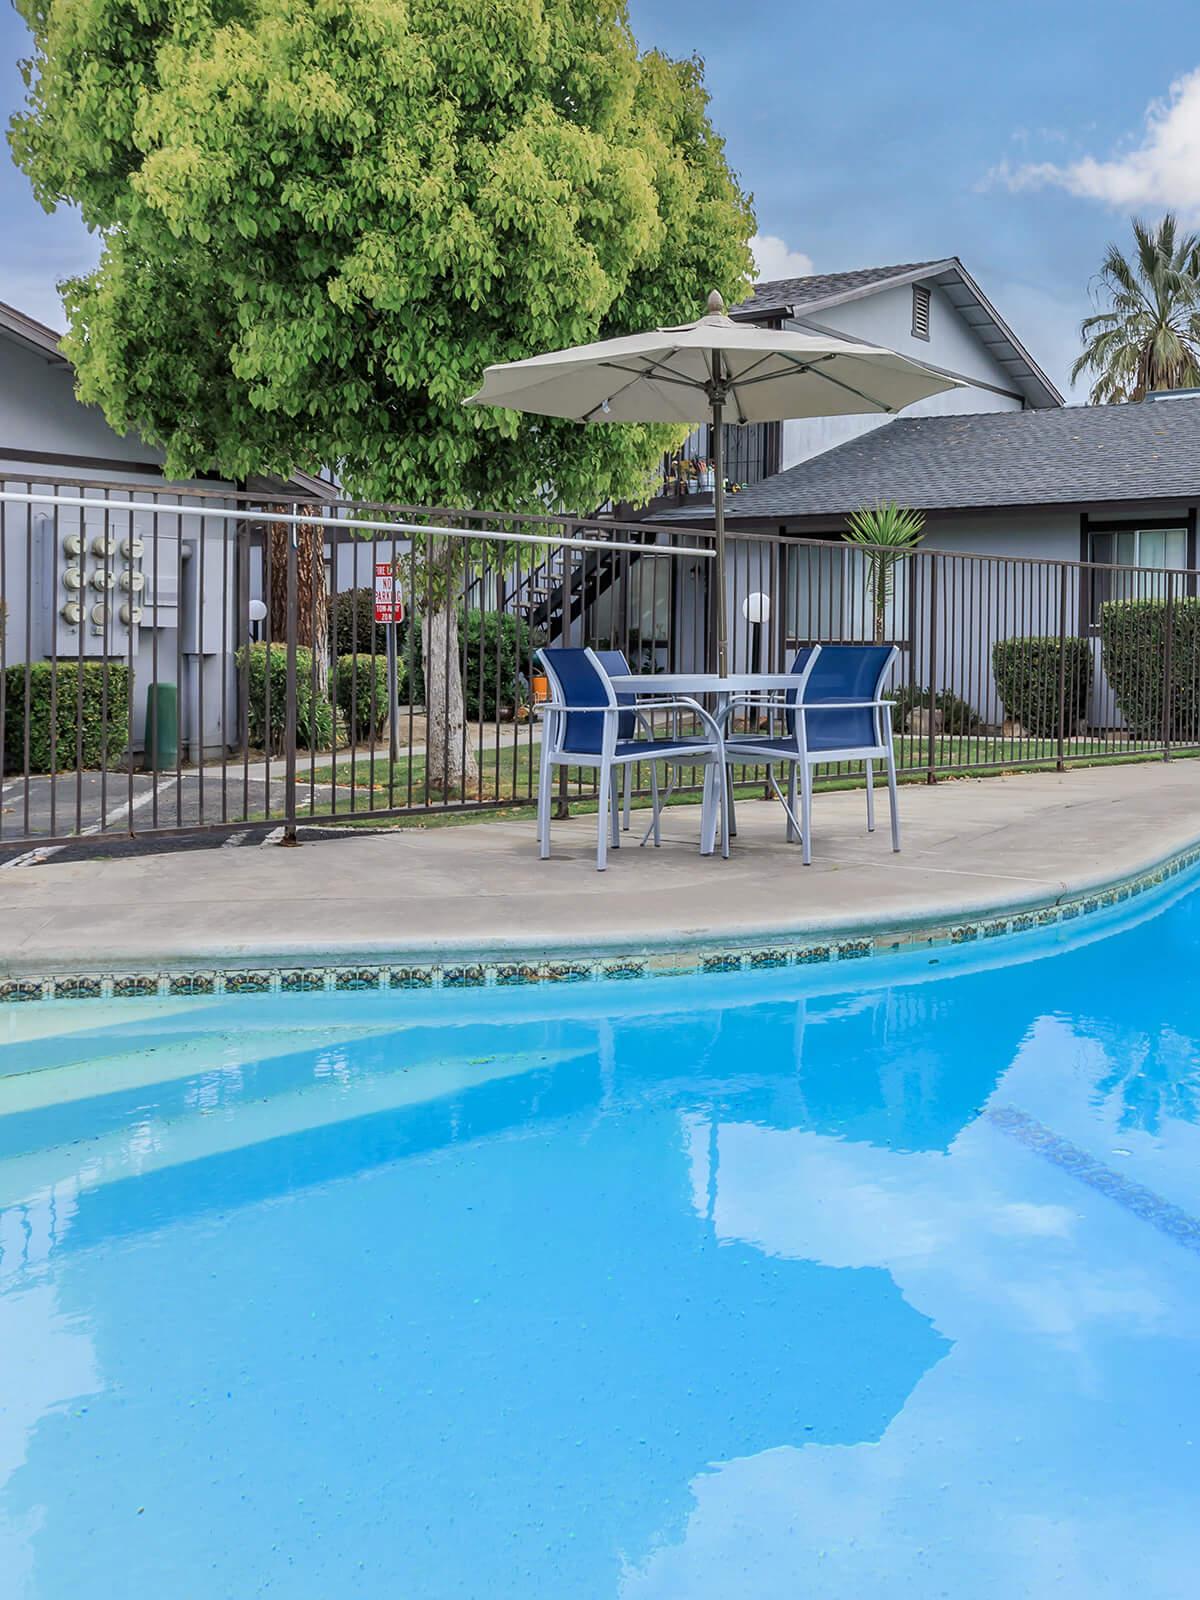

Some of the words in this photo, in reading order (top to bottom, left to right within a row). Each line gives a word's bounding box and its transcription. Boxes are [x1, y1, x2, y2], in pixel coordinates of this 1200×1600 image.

[383, 578, 392, 590] NO
[375, 591, 400, 602] PARKIG
[381, 613, 395, 621] ZON
